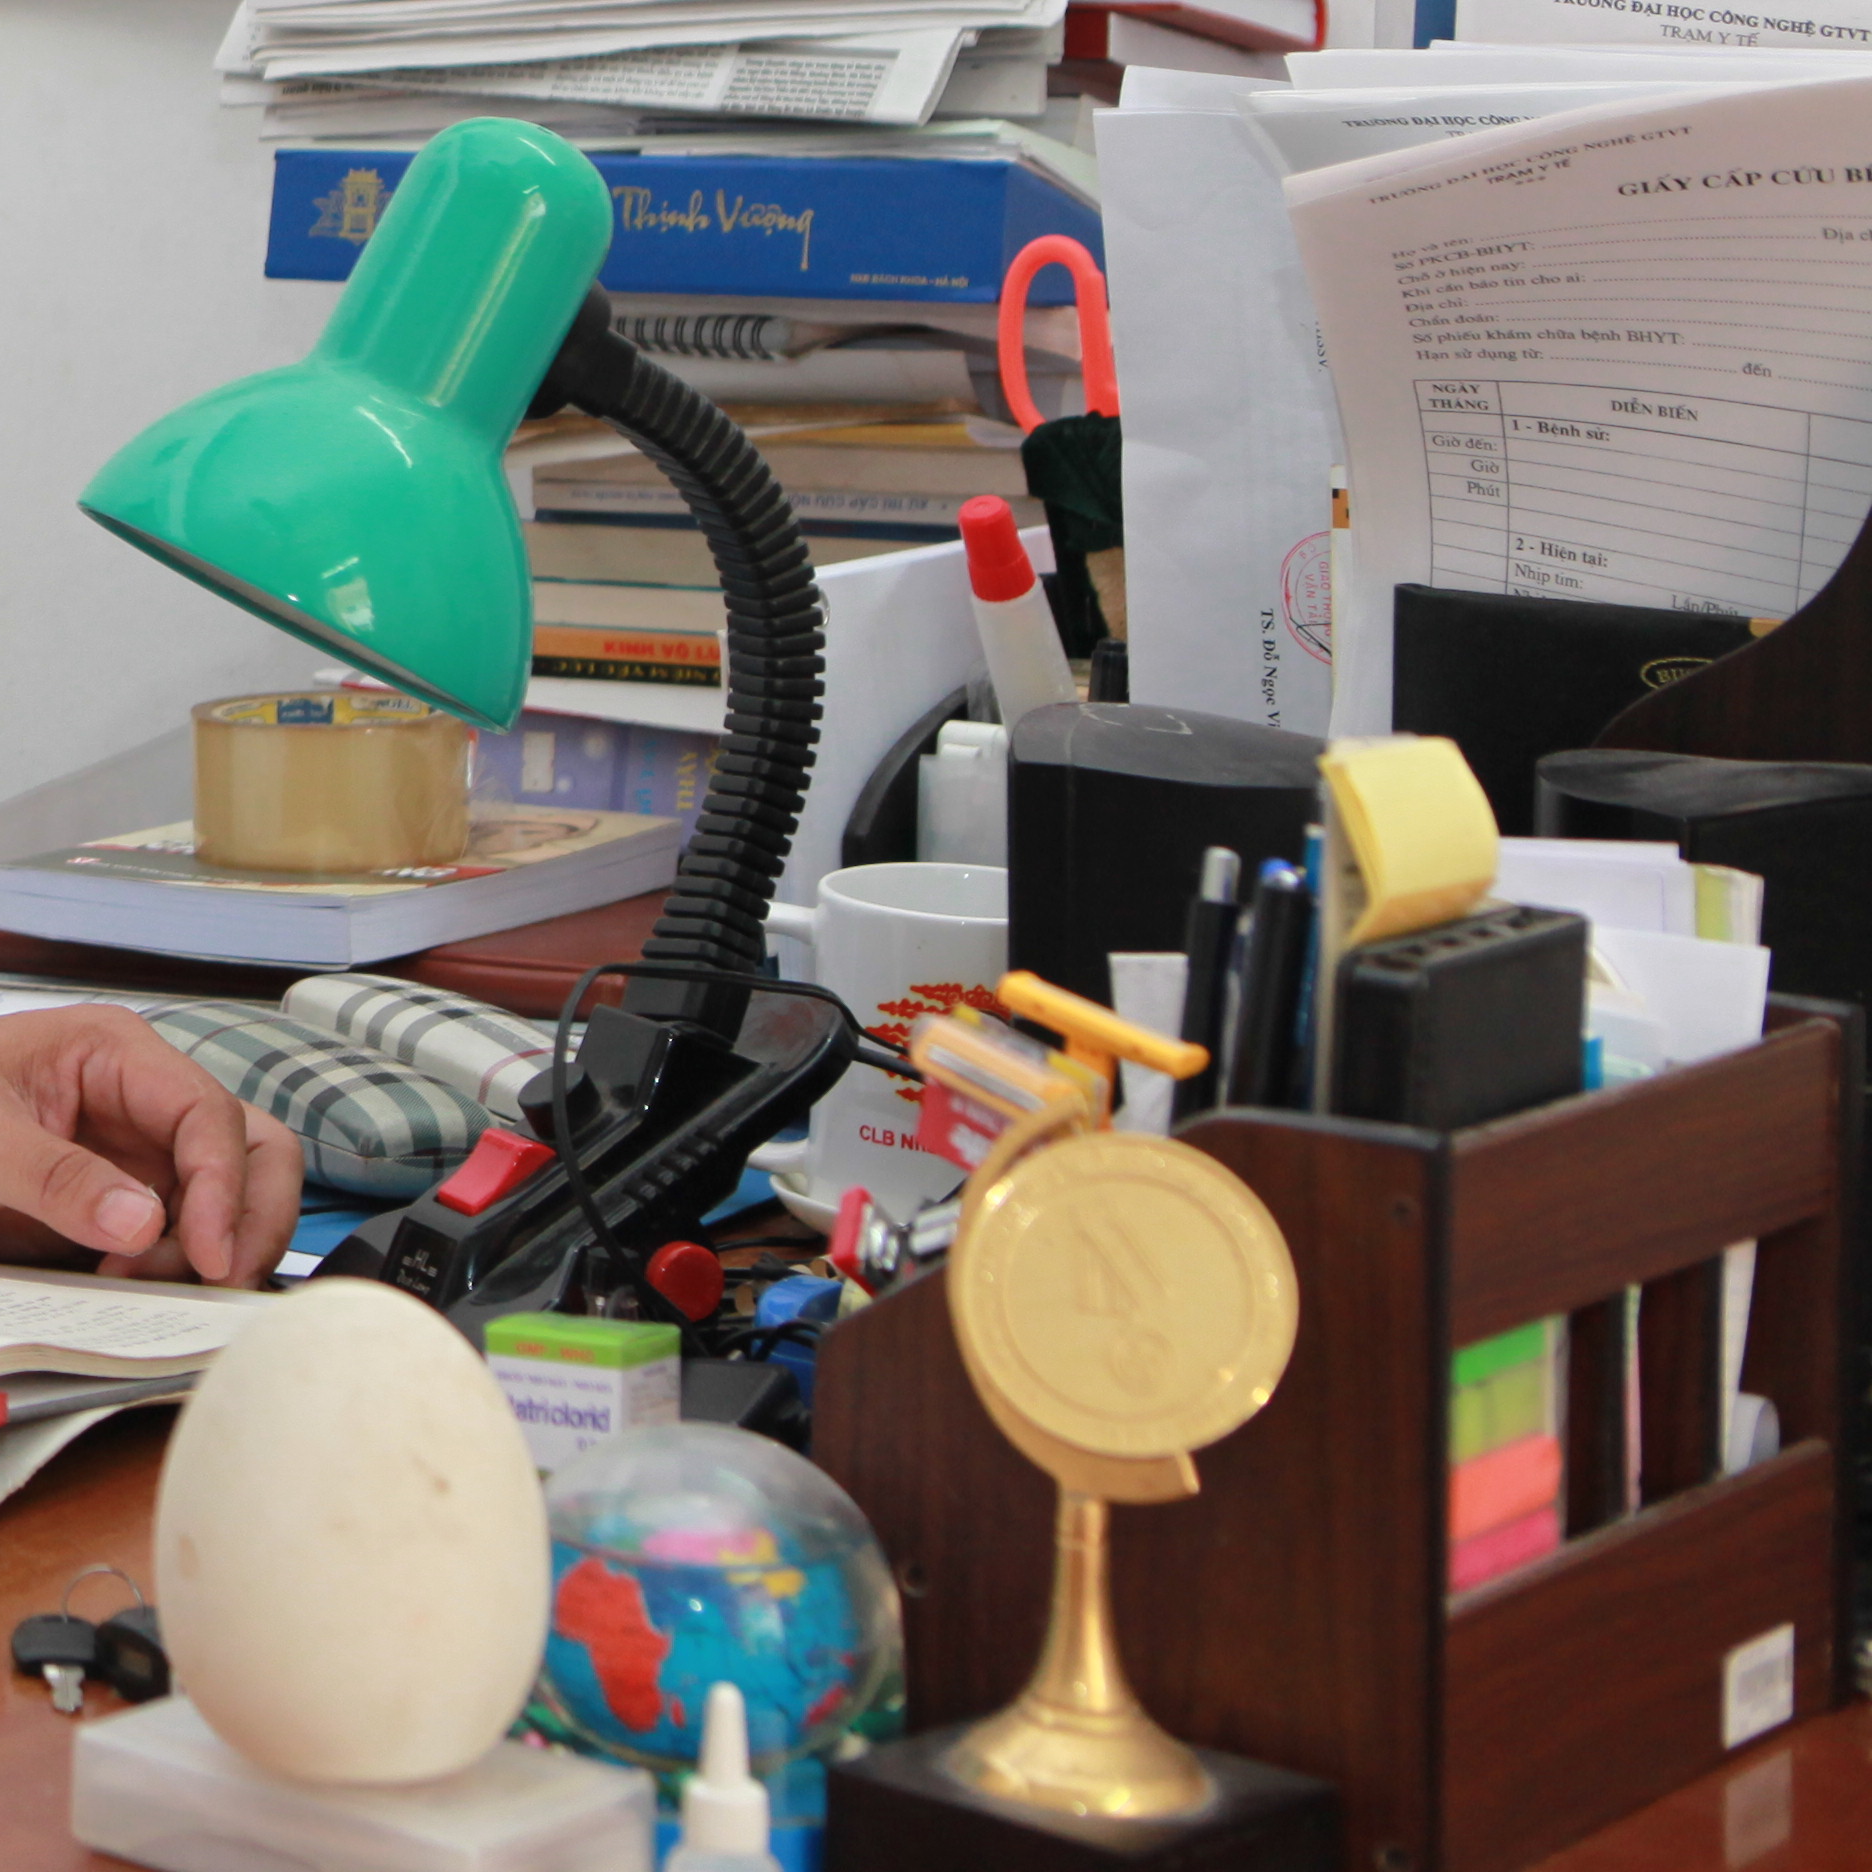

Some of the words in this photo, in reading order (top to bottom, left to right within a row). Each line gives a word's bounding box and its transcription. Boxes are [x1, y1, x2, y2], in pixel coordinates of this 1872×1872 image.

[1631, 0, 1662, 17] ĐẠI
[1666, 2, 1705, 23] HỌC
[1710, 7, 1759, 28] CÔNG
[1763, 16, 1816, 37] NGHỆ
[1820, 23, 1871, 42] GTVT
[1660, 23, 1713, 45] TRẠM
[1716, 31, 1732, 46] Y
[1735, 32, 1760, 48] TẾ
[1482, 159, 1522, 175] HỌC
[1525, 145, 1578, 164] CÔNG
[1641, 126, 1692, 142] GTVT
[1539, 163, 1549, 172] Y
[1618, 173, 1692, 196] GIẤY
[1702, 167, 1762, 189] CẤP
[1771, 165, 1835, 185] CỨU
[611, 185, 712, 232] Thịnh
[715, 188, 815, 270] Vượng
[1822, 228, 1855, 244] Địa
[1450, 266, 1486, 277] hiện
[1490, 261, 1526, 272] nay:
[1402, 288, 1431, 299] Khi
[1468, 280, 1499, 290] báo
[1503, 277, 1526, 287] tin
[1530, 274, 1562, 285] cho
[1566, 273, 1586, 283] ai:
[1406, 300, 1434, 313] Địa
[1454, 313, 1499, 324] đoán:
[1437, 330, 1481, 345] phiếu
[1485, 330, 1532, 340] khám
[1537, 329, 1576, 341] chữa
[1581, 330, 1621, 343] bệnh
[1626, 329, 1686, 345] BHYT:
[1416, 349, 1449, 361] Hạn
[1454, 347, 1472, 359] sử
[1477, 349, 1517, 361] dụng
[1522, 348, 1544, 360] từ:
[1742, 362, 1772, 378] đến
[1432, 382, 1481, 394] NGÀY
[1428, 397, 1489, 411] THÁNG
[1610, 396, 1654, 415] DIỄN
[1657, 404, 1699, 421] BIẾN
[1511, 419, 1520, 432] 1
[1537, 420, 1581, 438] Bệnh
[1585, 426, 1611, 442] sử:
[1432, 434, 1461, 449] Giờ
[1464, 436, 1498, 452] đến:
[1470, 459, 1500, 474] Giờ
[1466, 480, 1500, 498] Phút
[1515, 537, 1525, 551] 2
[1540, 541, 1577, 562] Hiện
[1582, 550, 1608, 568] tại:
[1305, 574, 1318, 598] VẬN
[1319, 561, 1331, 590] GIAO
[1514, 564, 1551, 586] Nhịp
[1554, 571, 1584, 590] tim:
[1260, 608, 1274, 634] TS.
[1262, 639, 1280, 661] Đỗ
[1261, 667, 1278, 705] Ngọc
[859, 1125, 895, 1146] CLB
